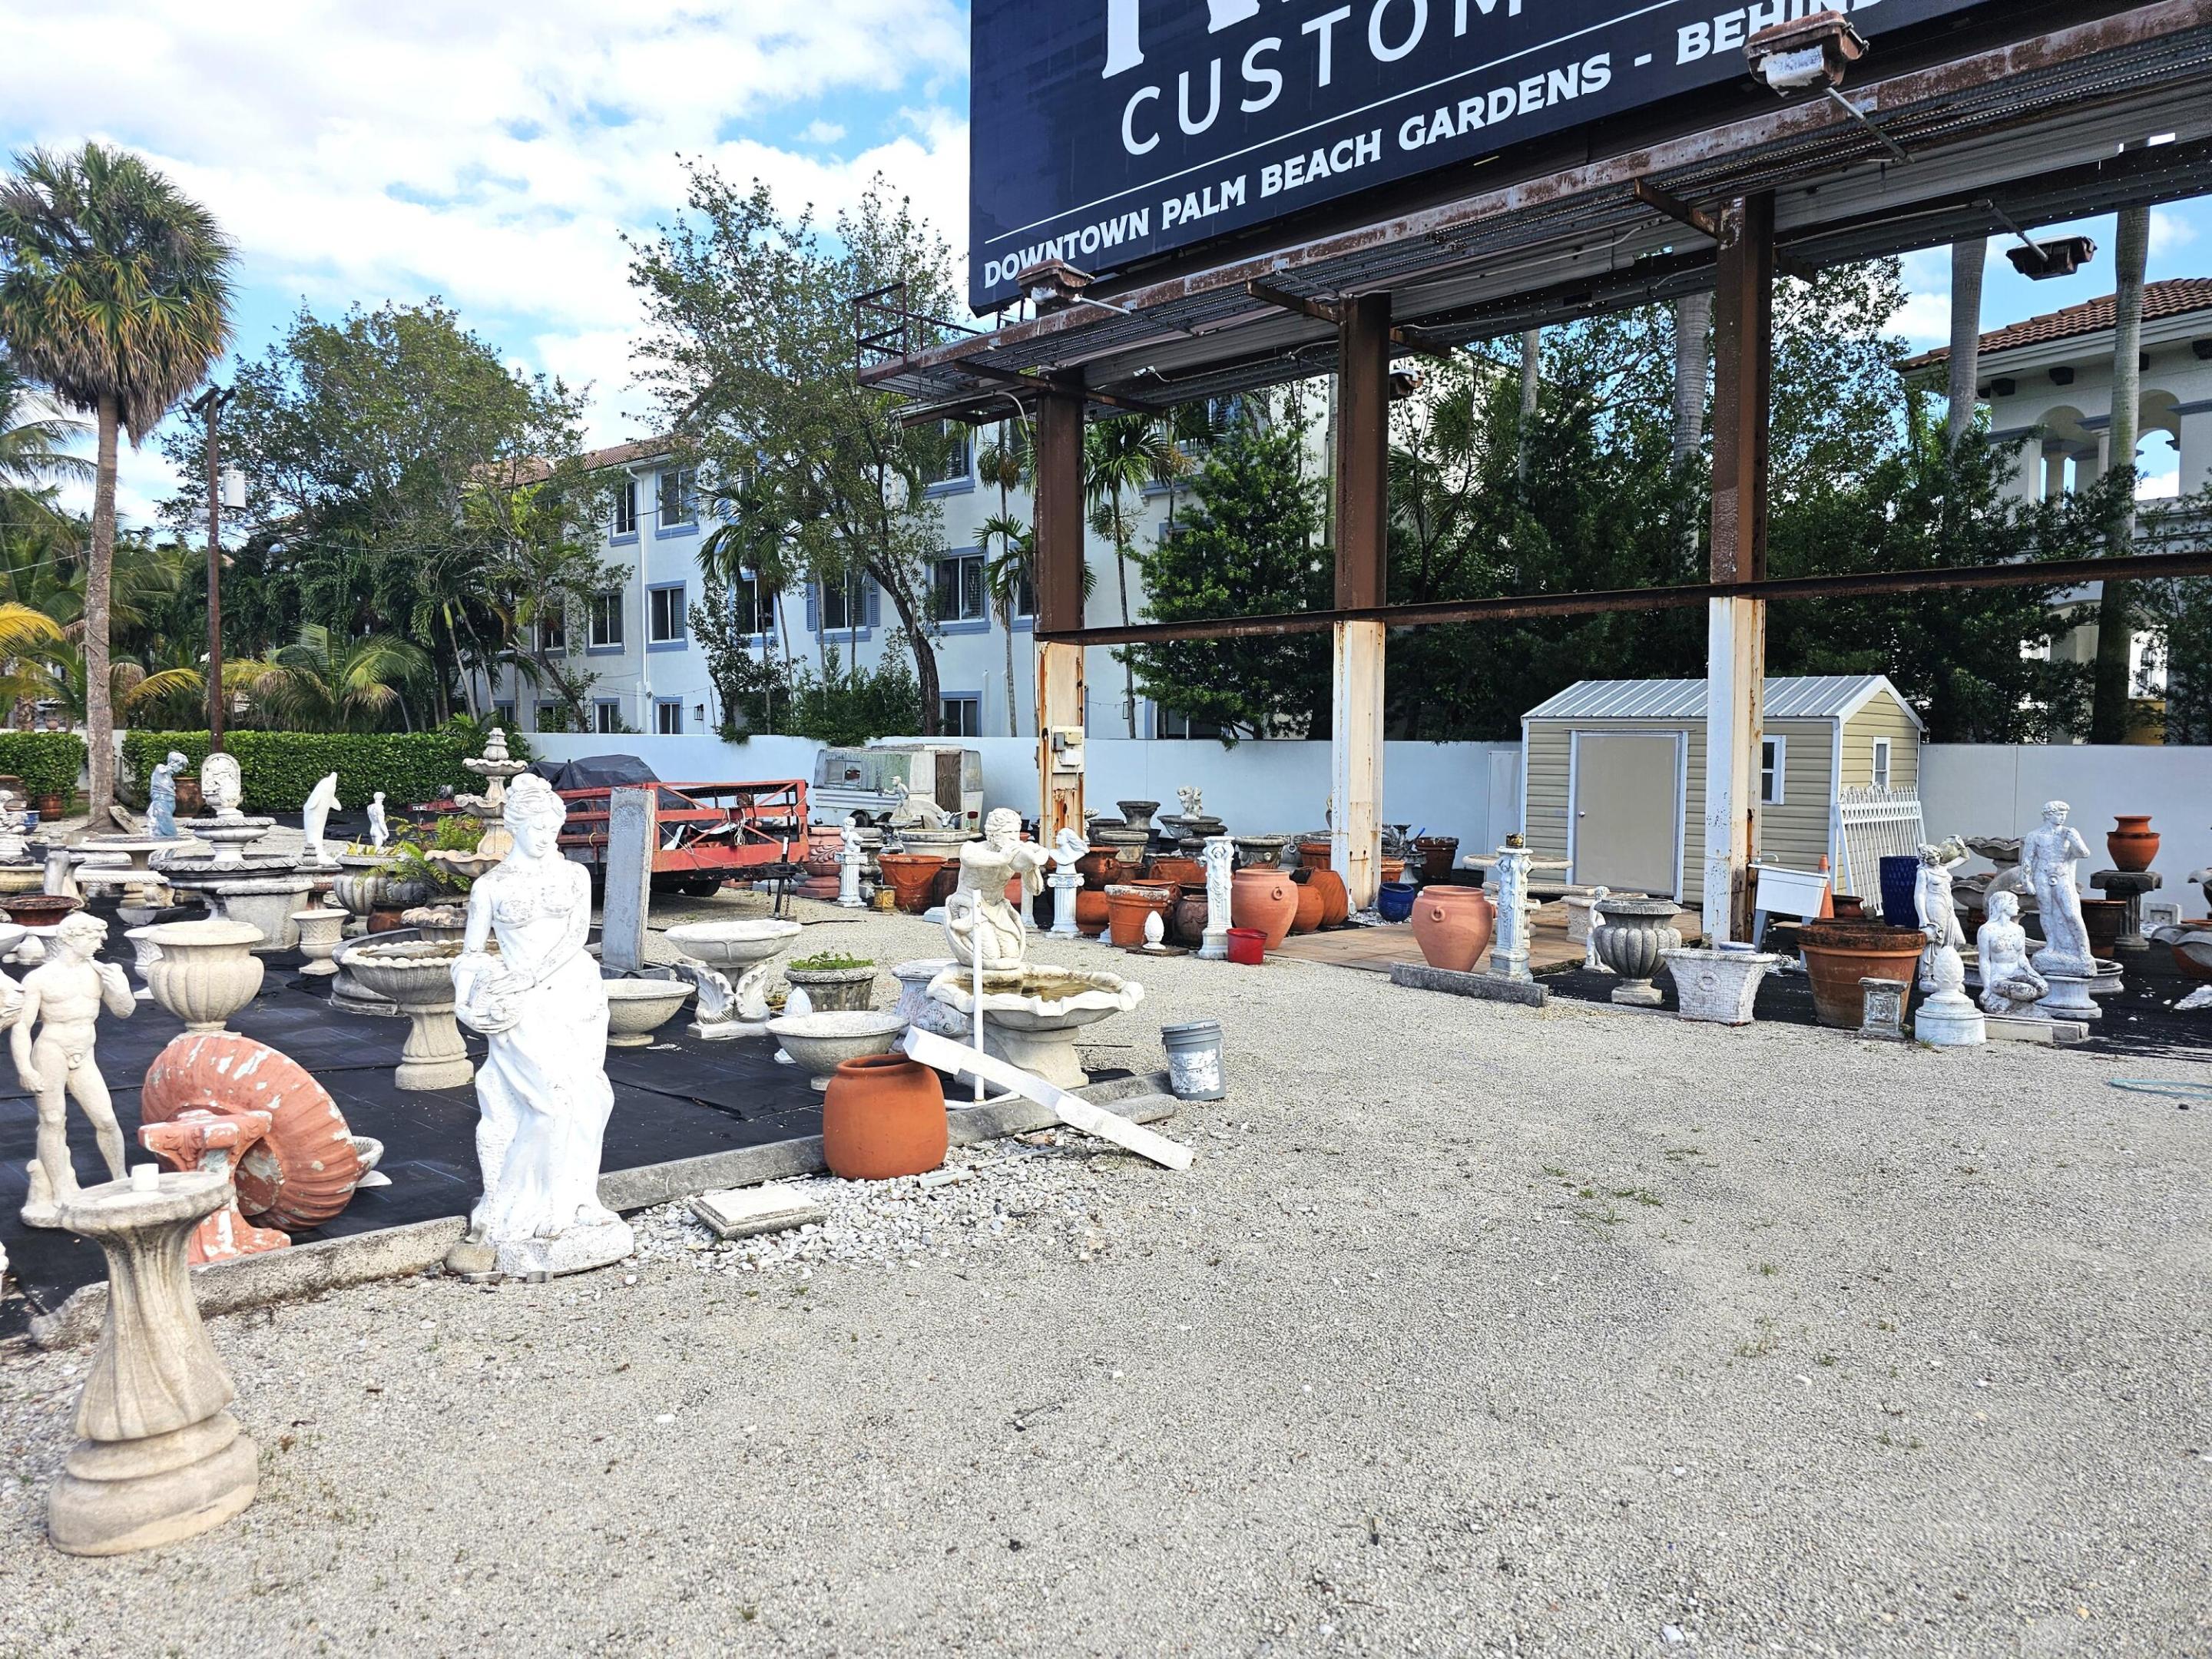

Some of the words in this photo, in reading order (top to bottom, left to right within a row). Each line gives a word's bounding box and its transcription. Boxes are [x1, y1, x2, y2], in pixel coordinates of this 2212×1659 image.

[984, 207, 1150, 289] DOWNTOWN
[1162, 174, 1247, 230] PALM
[1260, 128, 1382, 198] BEACH
[1398, 52, 1612, 151] GARDENS
[1676, 0, 1882, 66] BEHI
